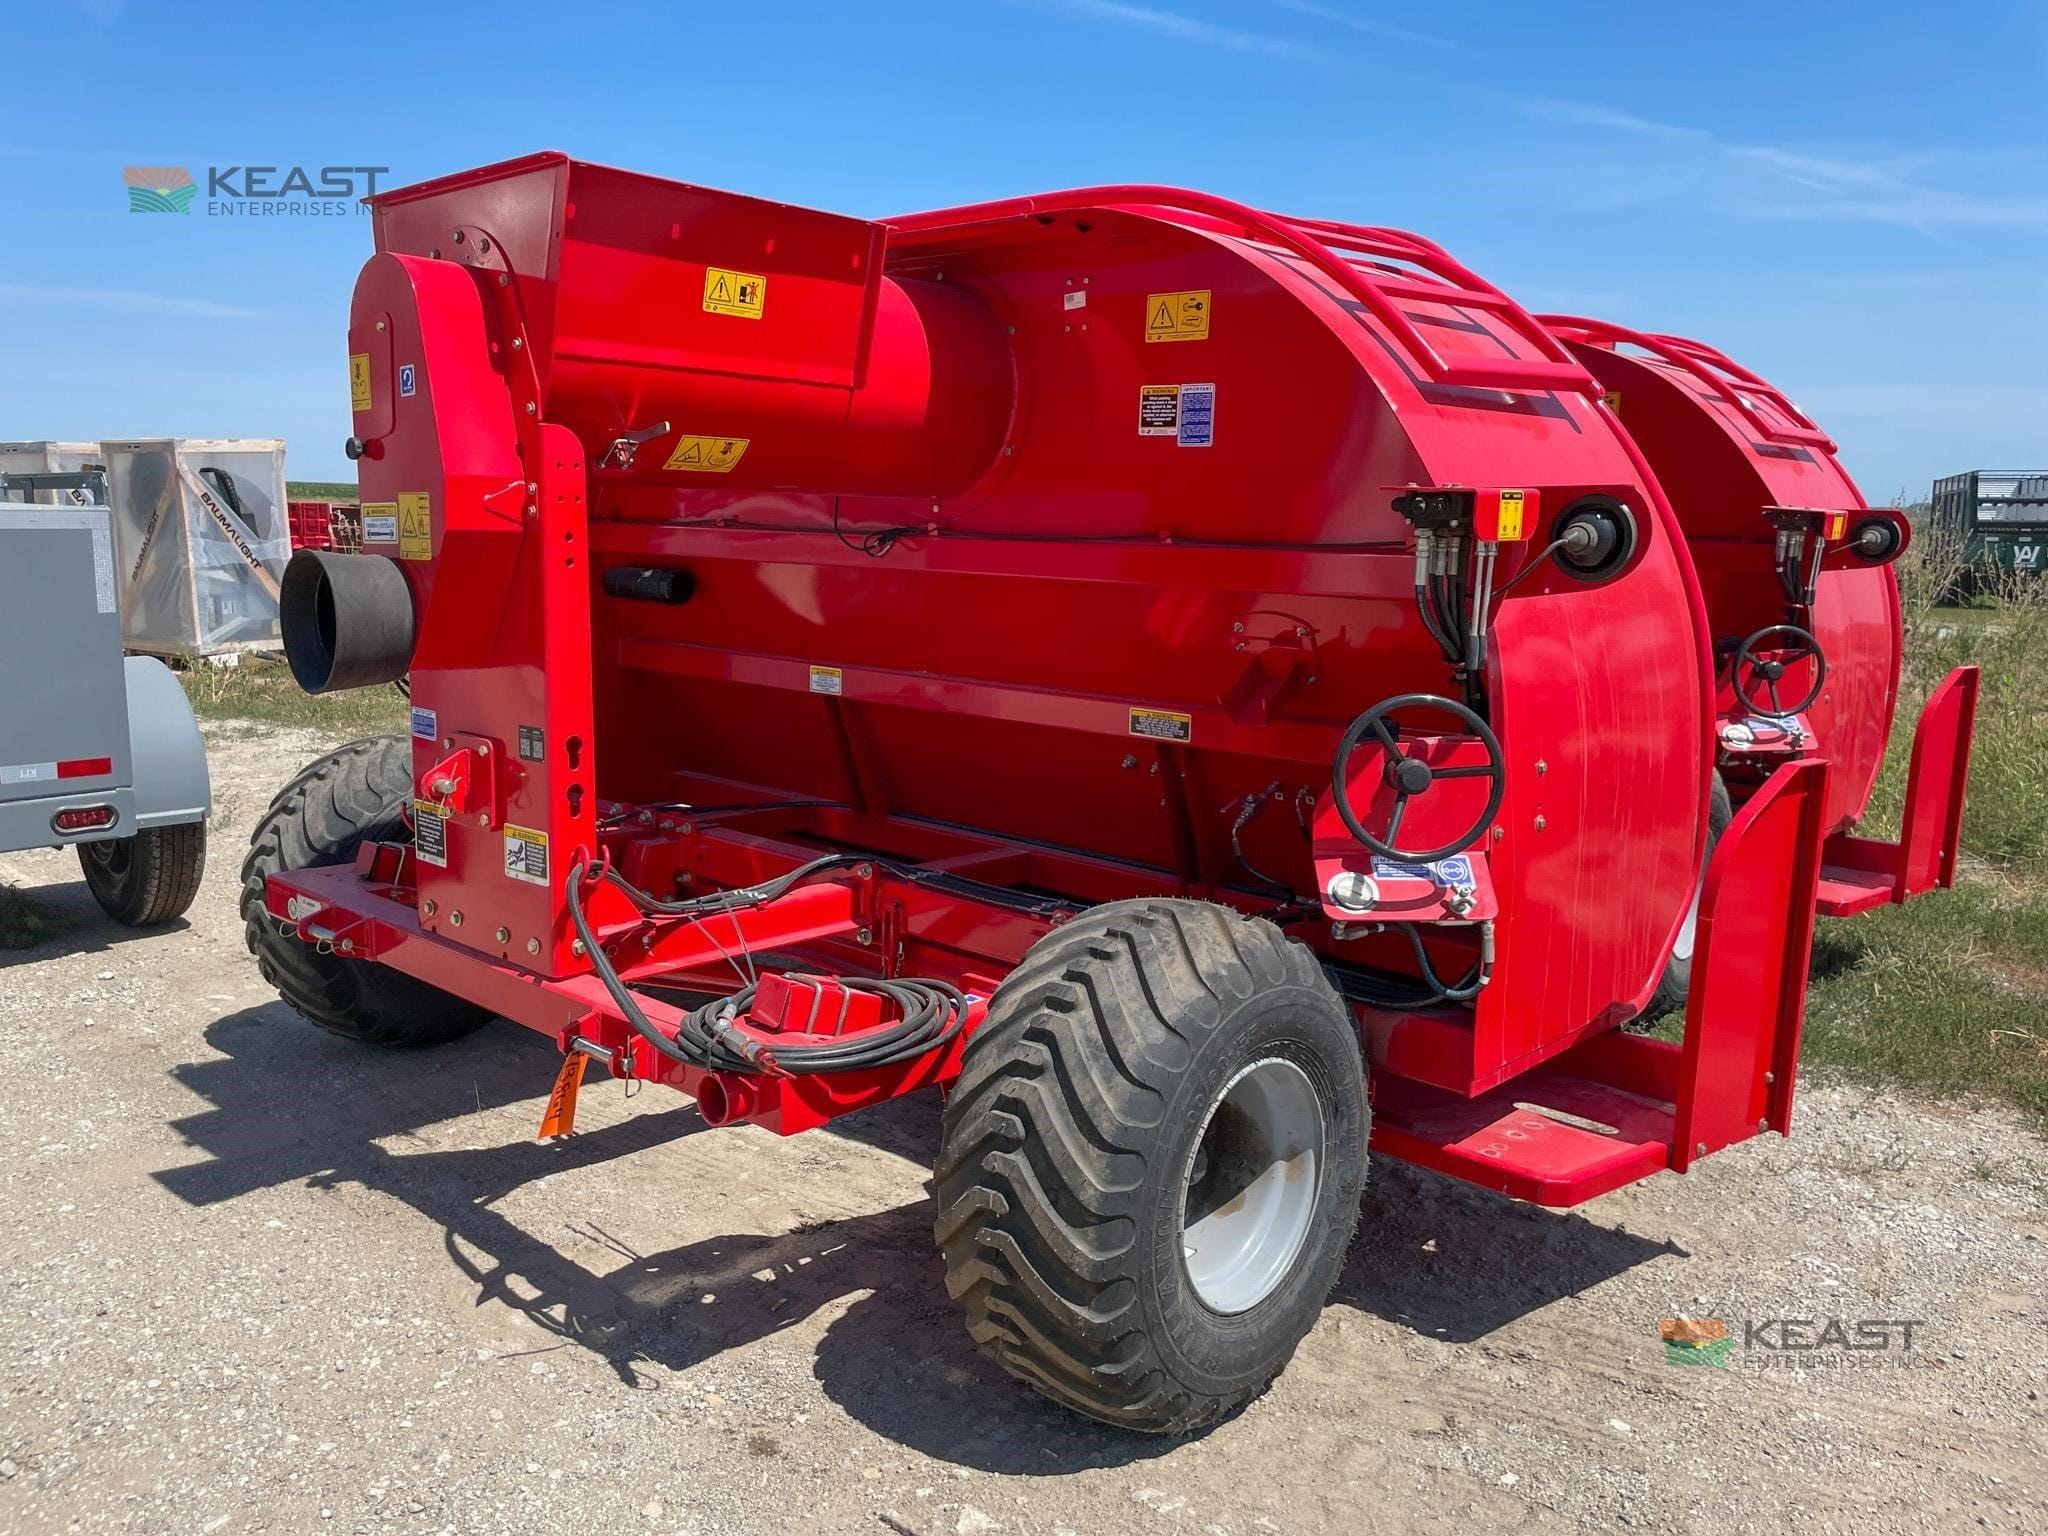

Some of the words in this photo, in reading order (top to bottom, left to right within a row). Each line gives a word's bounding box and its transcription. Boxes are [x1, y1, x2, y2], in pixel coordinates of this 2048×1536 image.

[132, 510, 160, 582] BAUMALIGHT
[200, 492, 263, 569] BAUMALIGHT
[516, 831, 540, 842] WARNING
